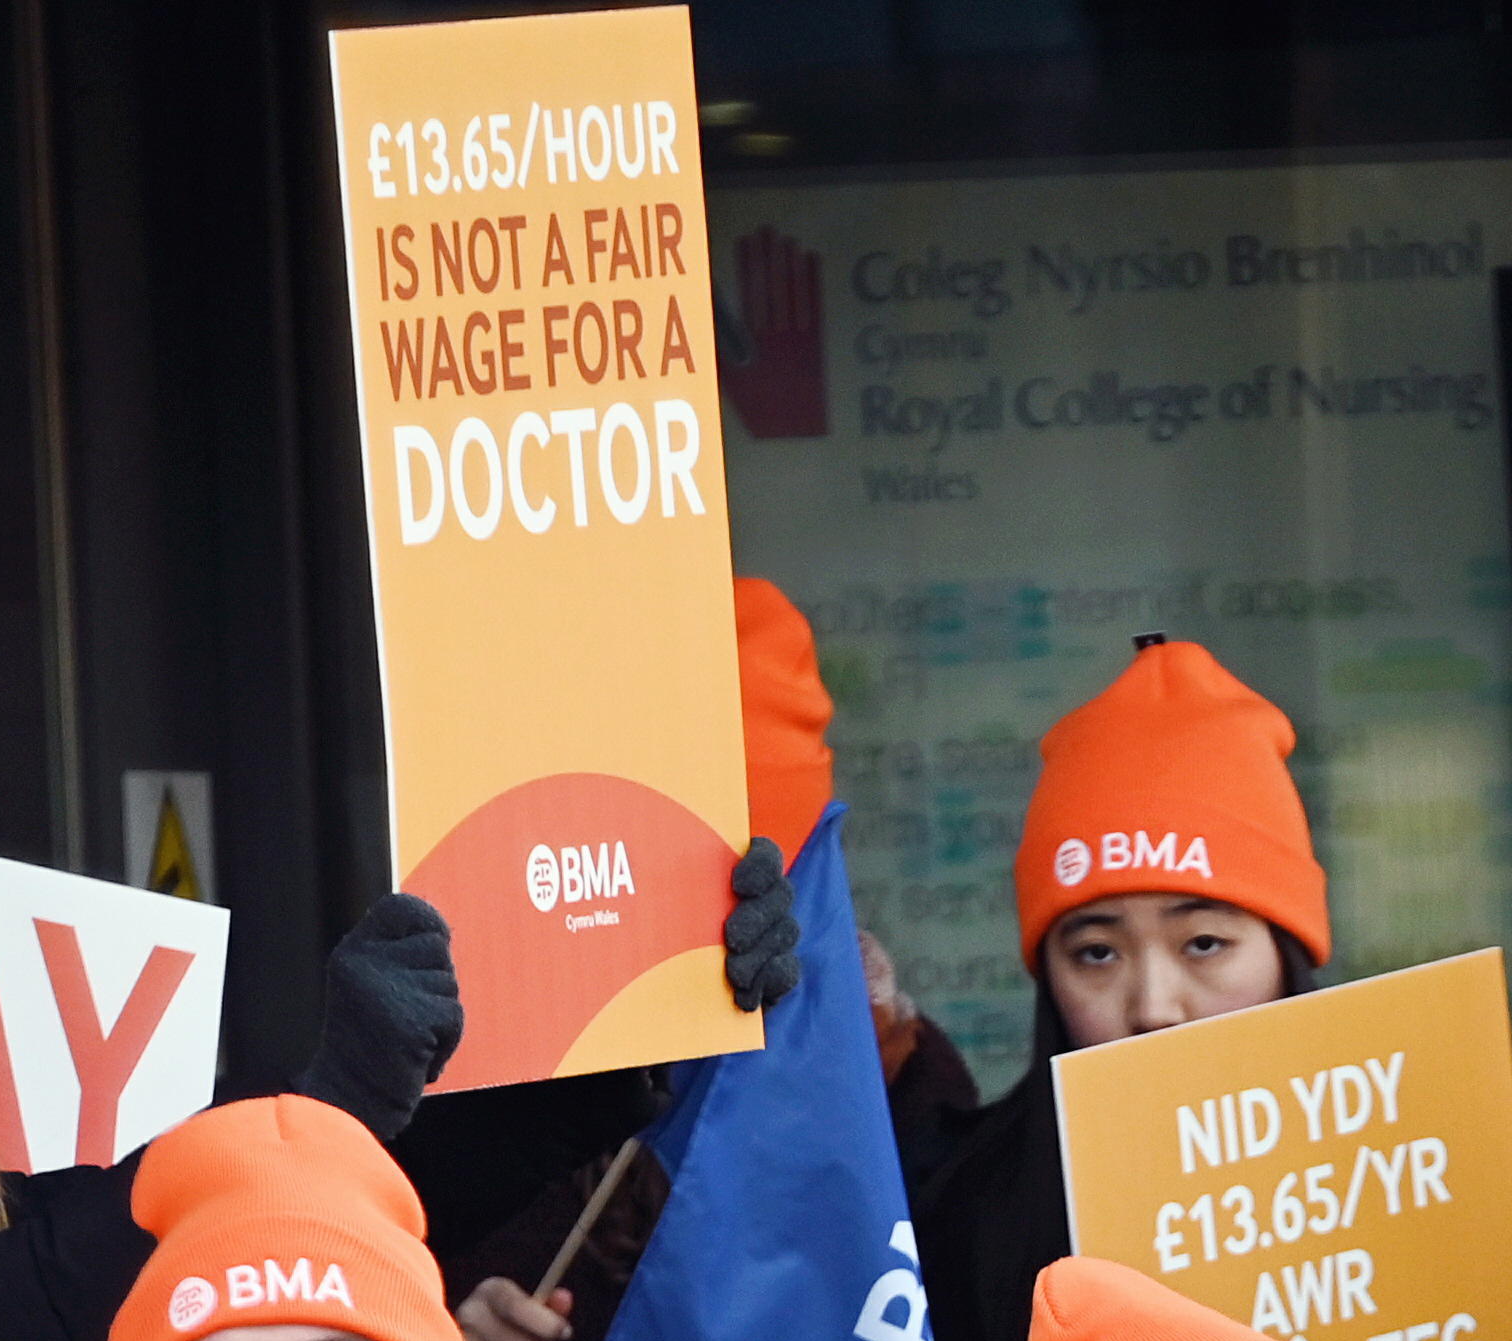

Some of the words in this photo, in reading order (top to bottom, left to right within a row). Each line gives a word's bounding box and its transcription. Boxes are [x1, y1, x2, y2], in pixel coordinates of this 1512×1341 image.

[368, 101, 680, 198] £13.65/HOUR
[376, 223, 419, 301] IS
[431, 215, 527, 298] NOT
[541, 212, 575, 288] A
[583, 202, 687, 284] FAIR
[379, 308, 532, 403] WAGE
[542, 298, 647, 388] FOR
[659, 294, 697, 377] A
[860, 378, 1001, 454] Royal
[1222, 367, 1276, 421] of
[393, 398, 707, 546] DOCTOR
[561, 840, 635, 904] BMA
[1100, 830, 1214, 880] BMA
[1176, 1087, 1282, 1173] NID
[1290, 1052, 1405, 1142] YDY
[1154, 1137, 1452, 1274] £13.65/YR
[226, 1257, 356, 1310] BMA
[1251, 1249, 1377, 1336] AWR
